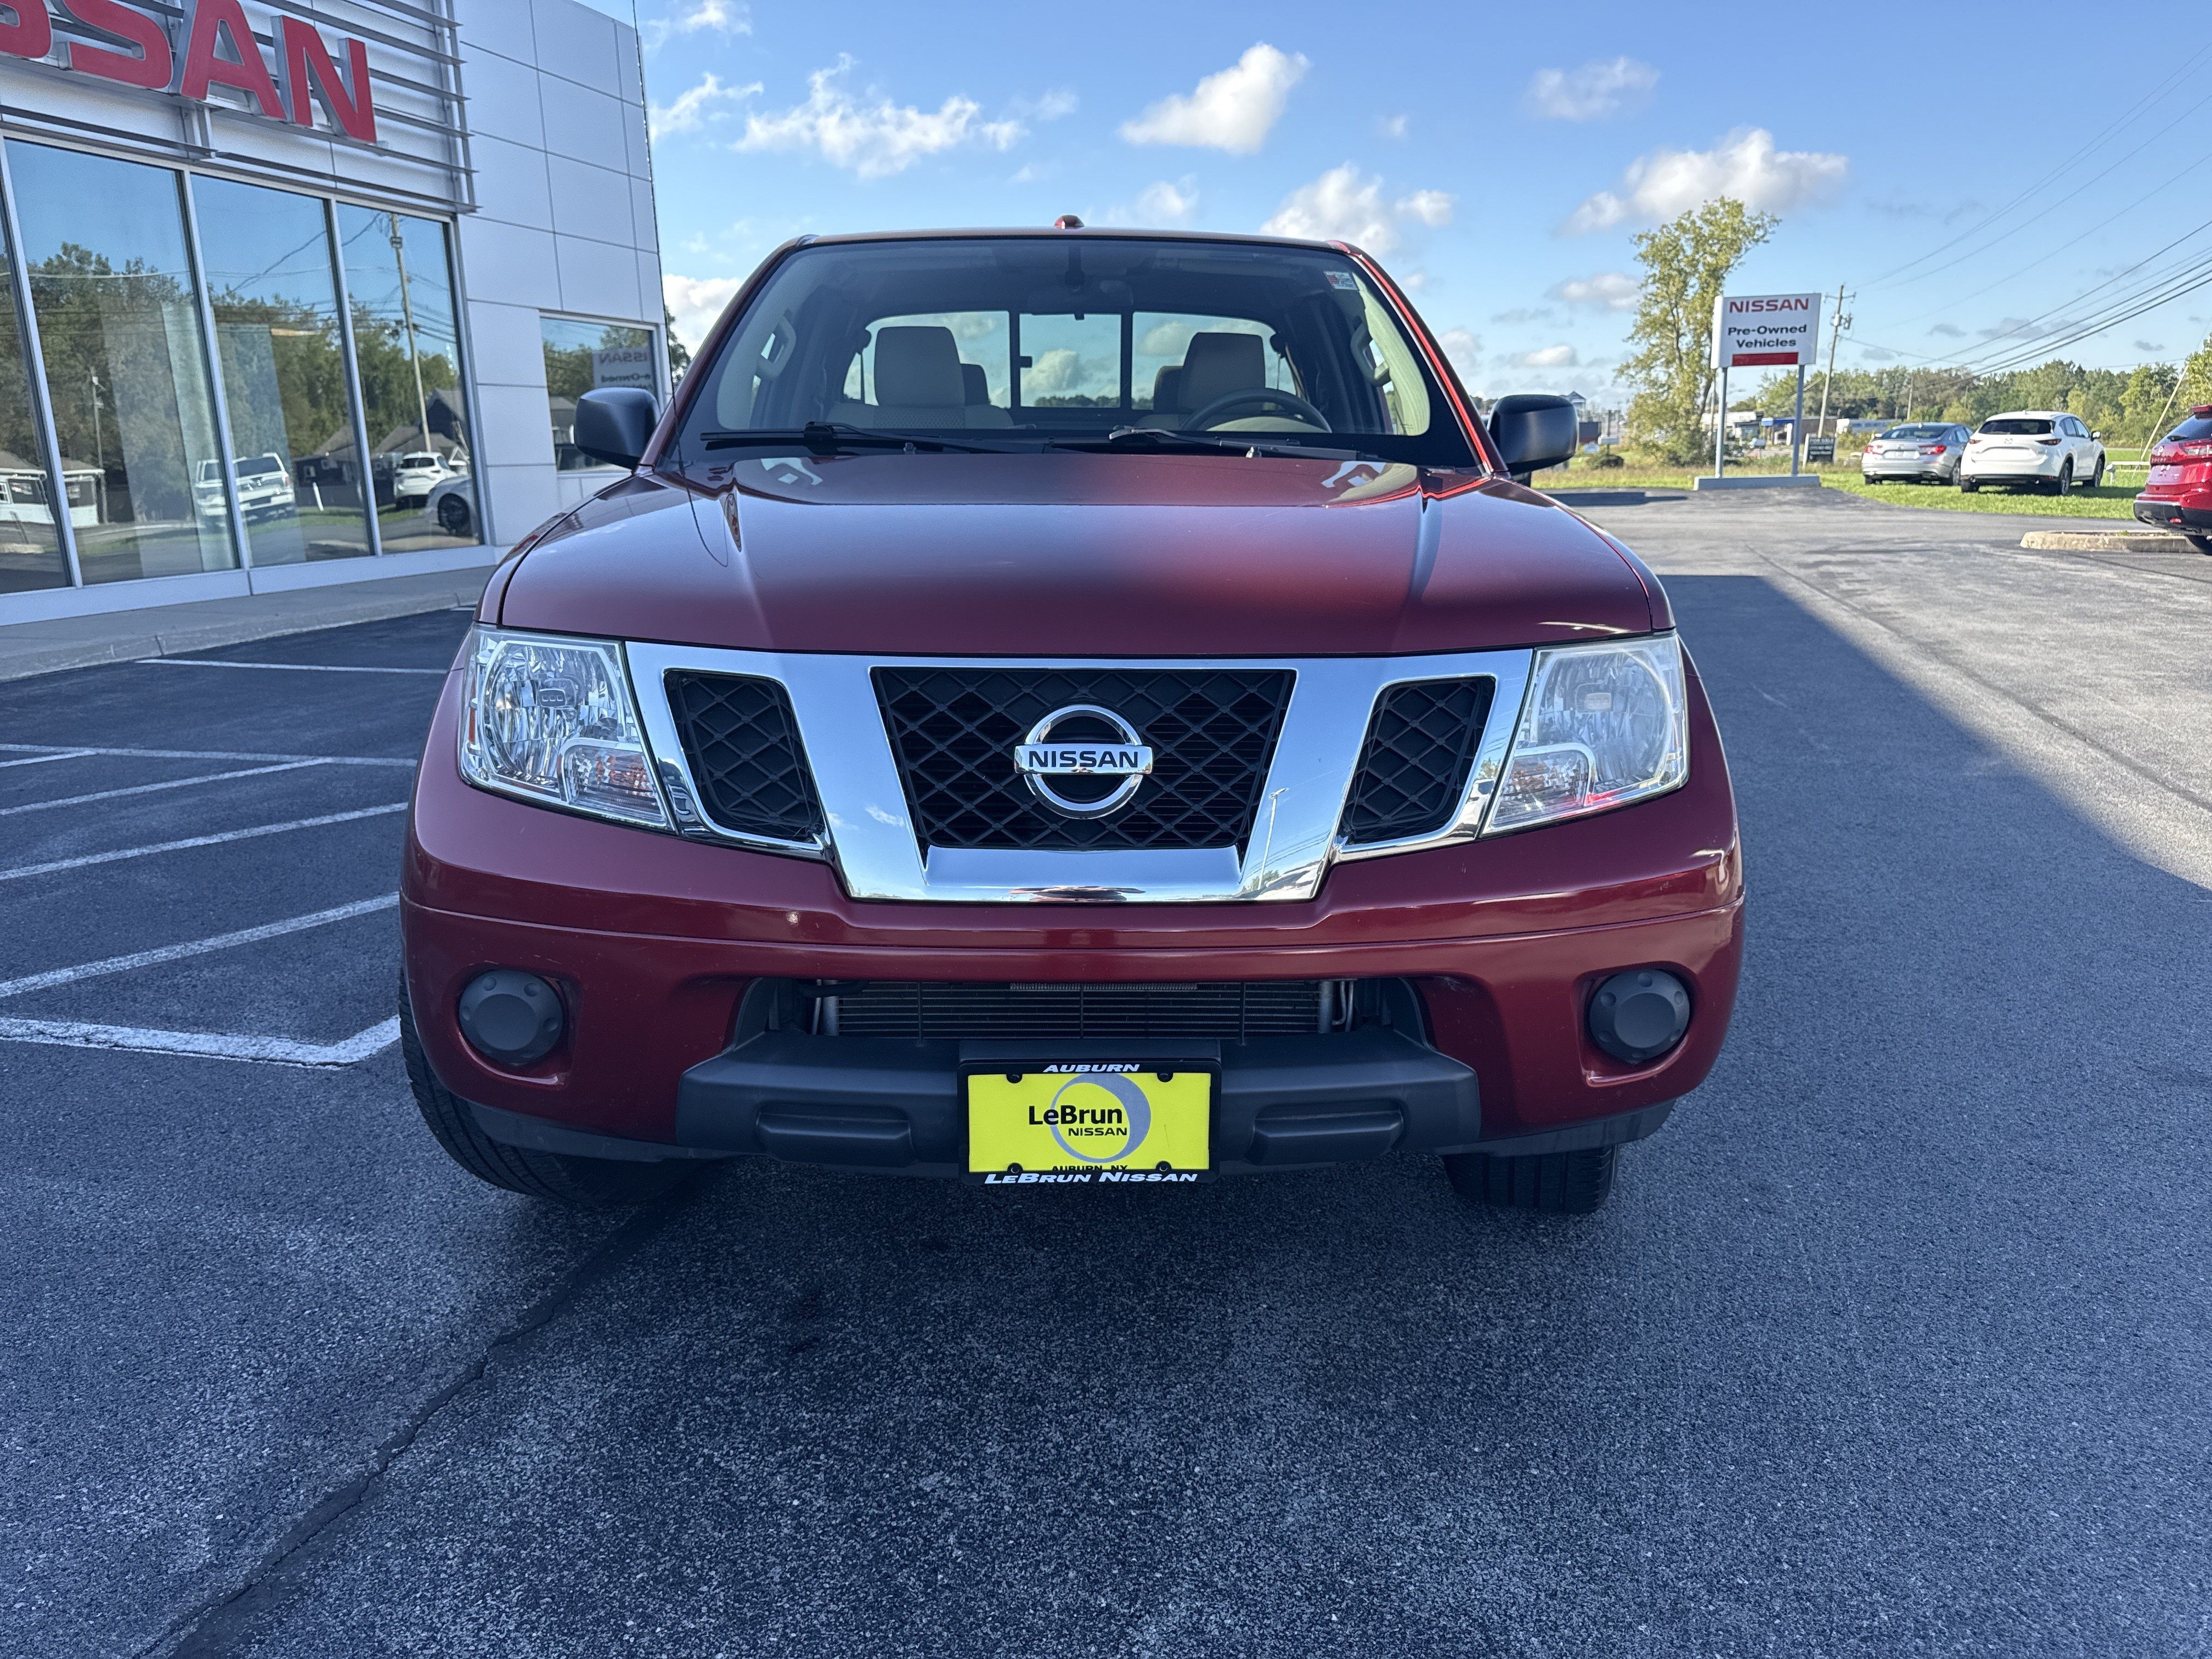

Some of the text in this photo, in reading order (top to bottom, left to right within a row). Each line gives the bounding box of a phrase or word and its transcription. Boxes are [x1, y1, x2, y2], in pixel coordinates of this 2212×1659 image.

[1729, 298, 1809, 313] NISSAN
[1728, 324, 1807, 336] Pre-Owned
[1736, 338, 1797, 348] Vehicles
[1029, 751, 1138, 768] NISSAN
[1043, 1064, 1140, 1073] AUBURN
[1029, 1104, 1122, 1125] LeBrun
[1068, 1127, 1127, 1136] NISSAN
